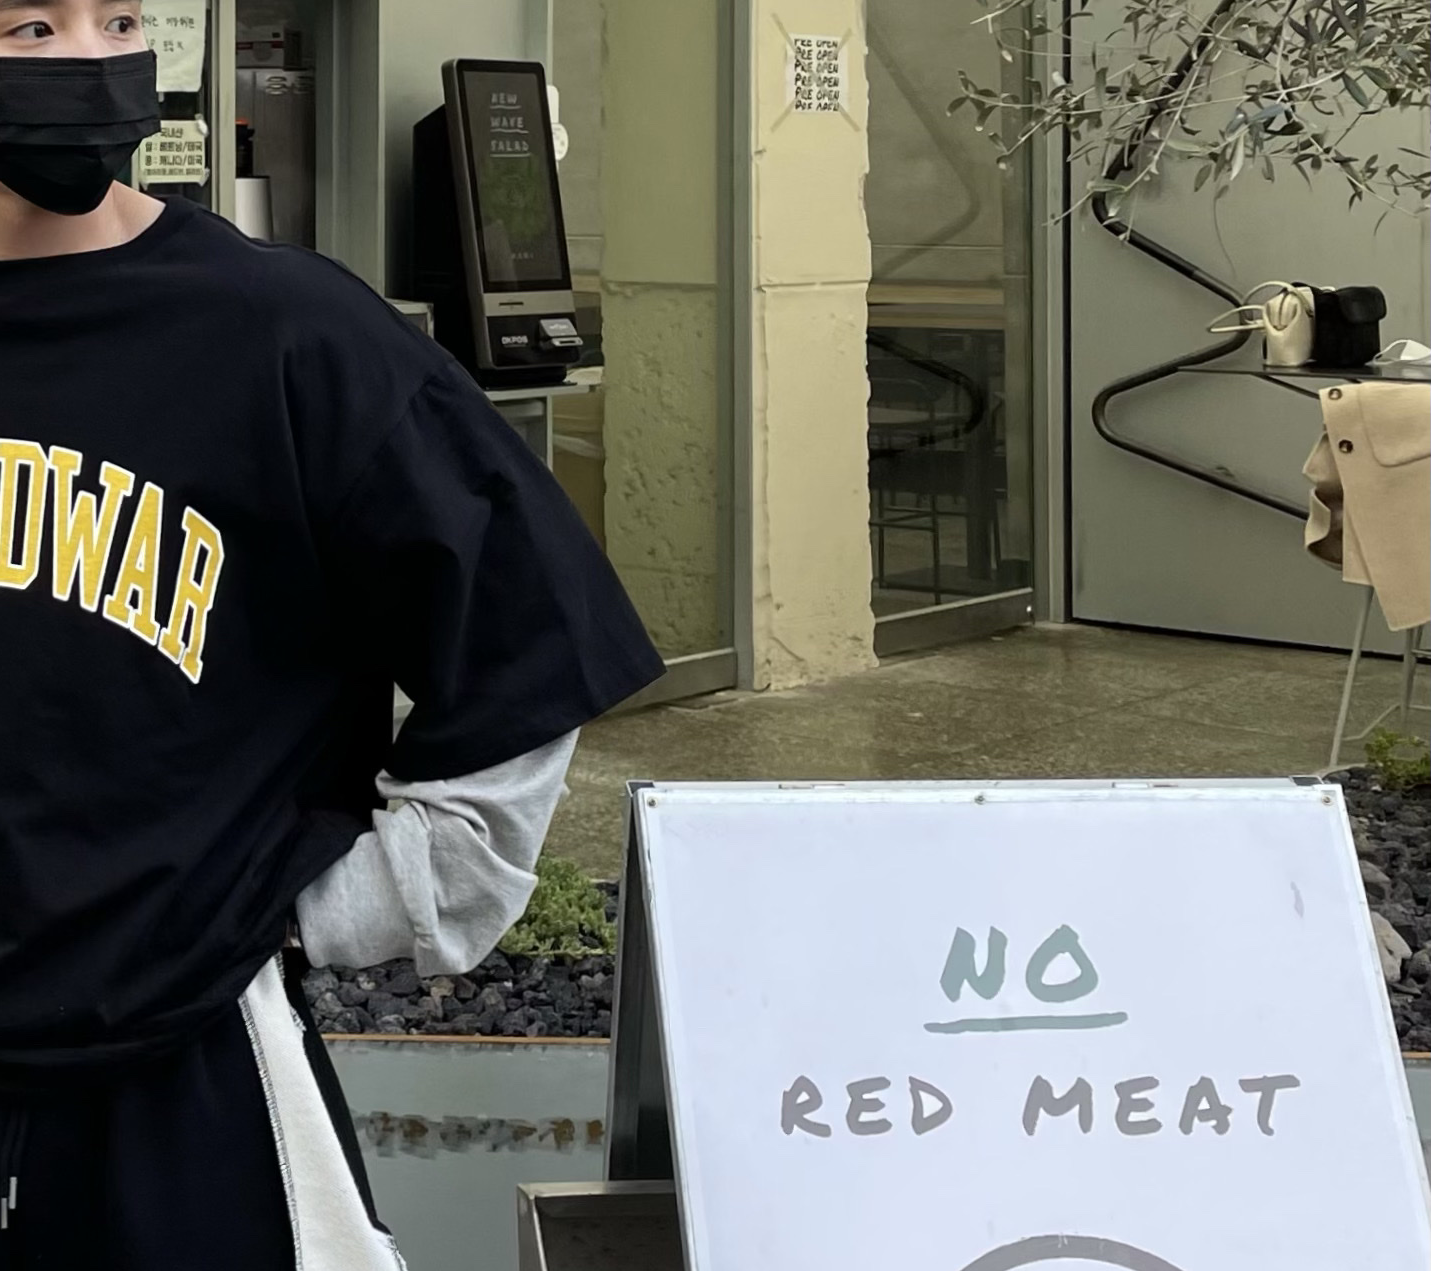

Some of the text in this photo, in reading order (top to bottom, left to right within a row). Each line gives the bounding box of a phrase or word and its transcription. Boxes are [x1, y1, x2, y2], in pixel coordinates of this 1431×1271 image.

[938, 923, 1099, 1003] NO
[780, 1074, 1302, 1138] RED MEAT
